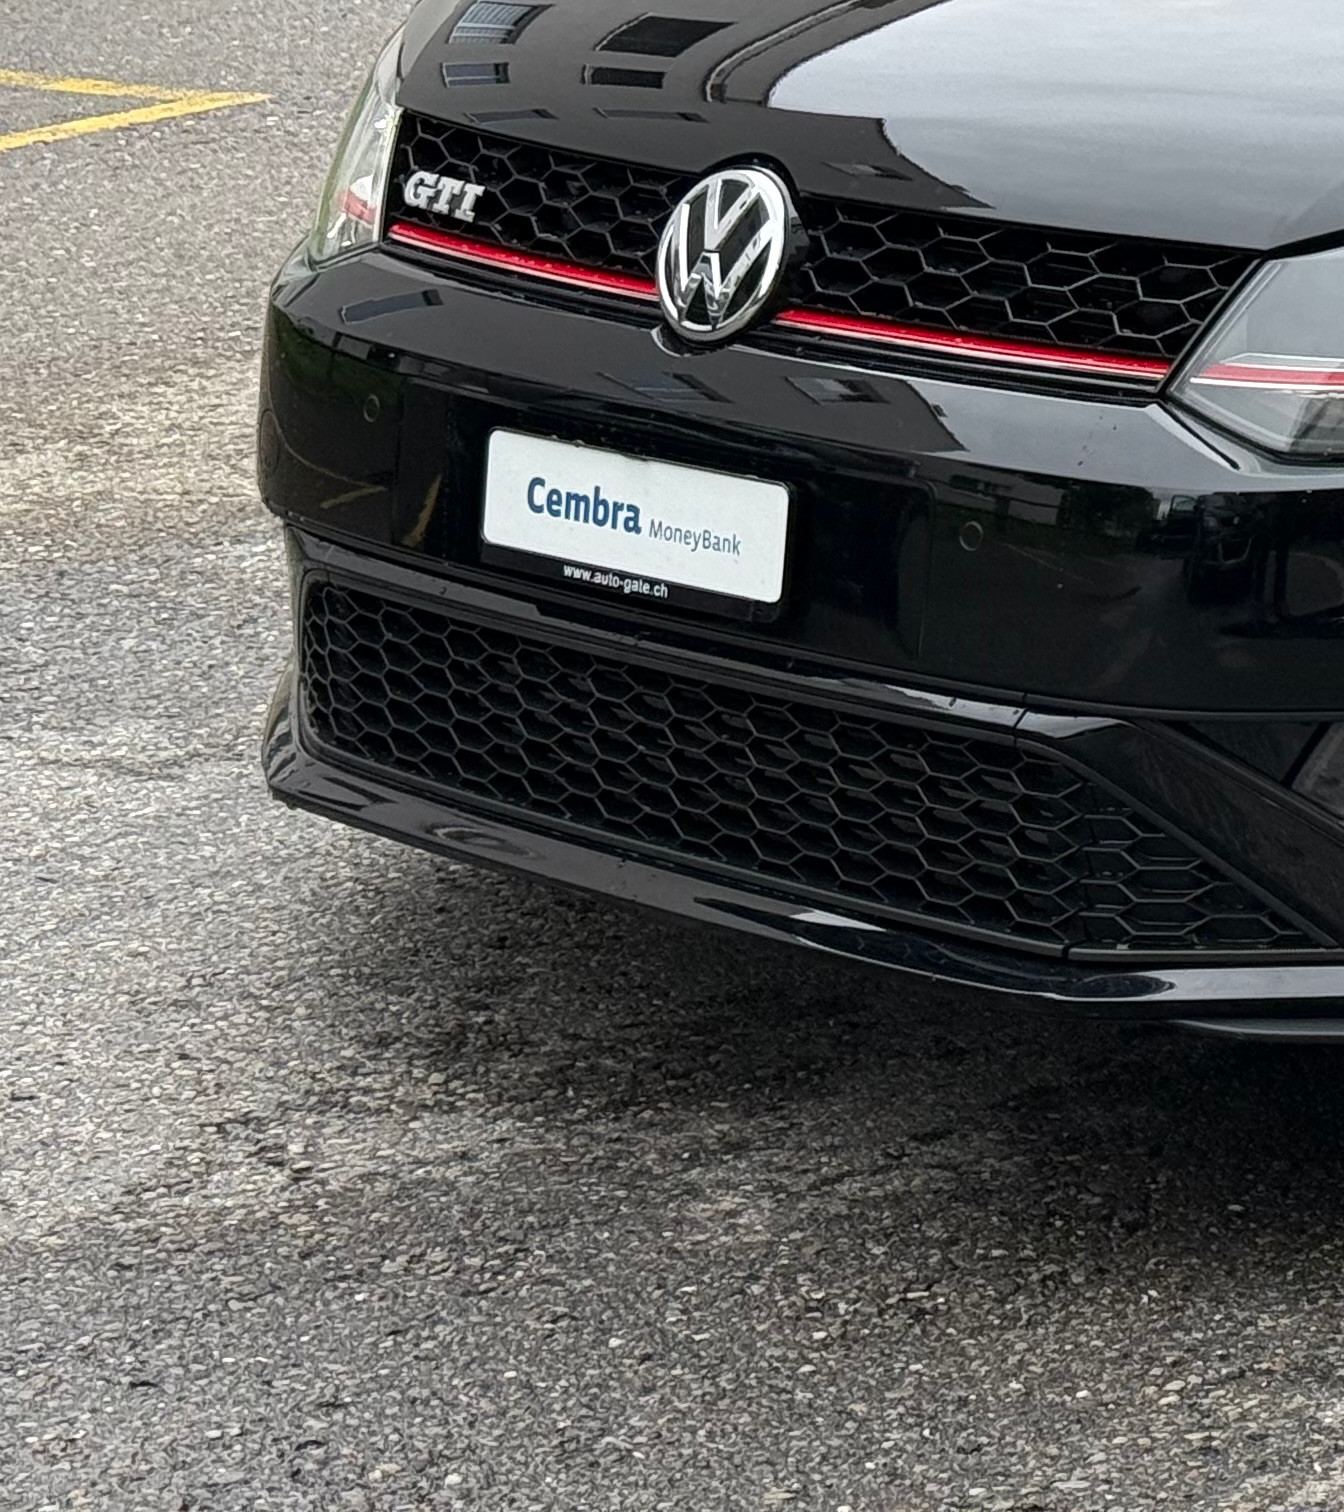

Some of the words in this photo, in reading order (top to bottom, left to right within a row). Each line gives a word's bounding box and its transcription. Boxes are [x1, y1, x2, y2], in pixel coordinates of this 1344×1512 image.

[404, 170, 485, 223] GTI
[527, 476, 642, 535] Cembra
[649, 519, 741, 556] MoneyBank
